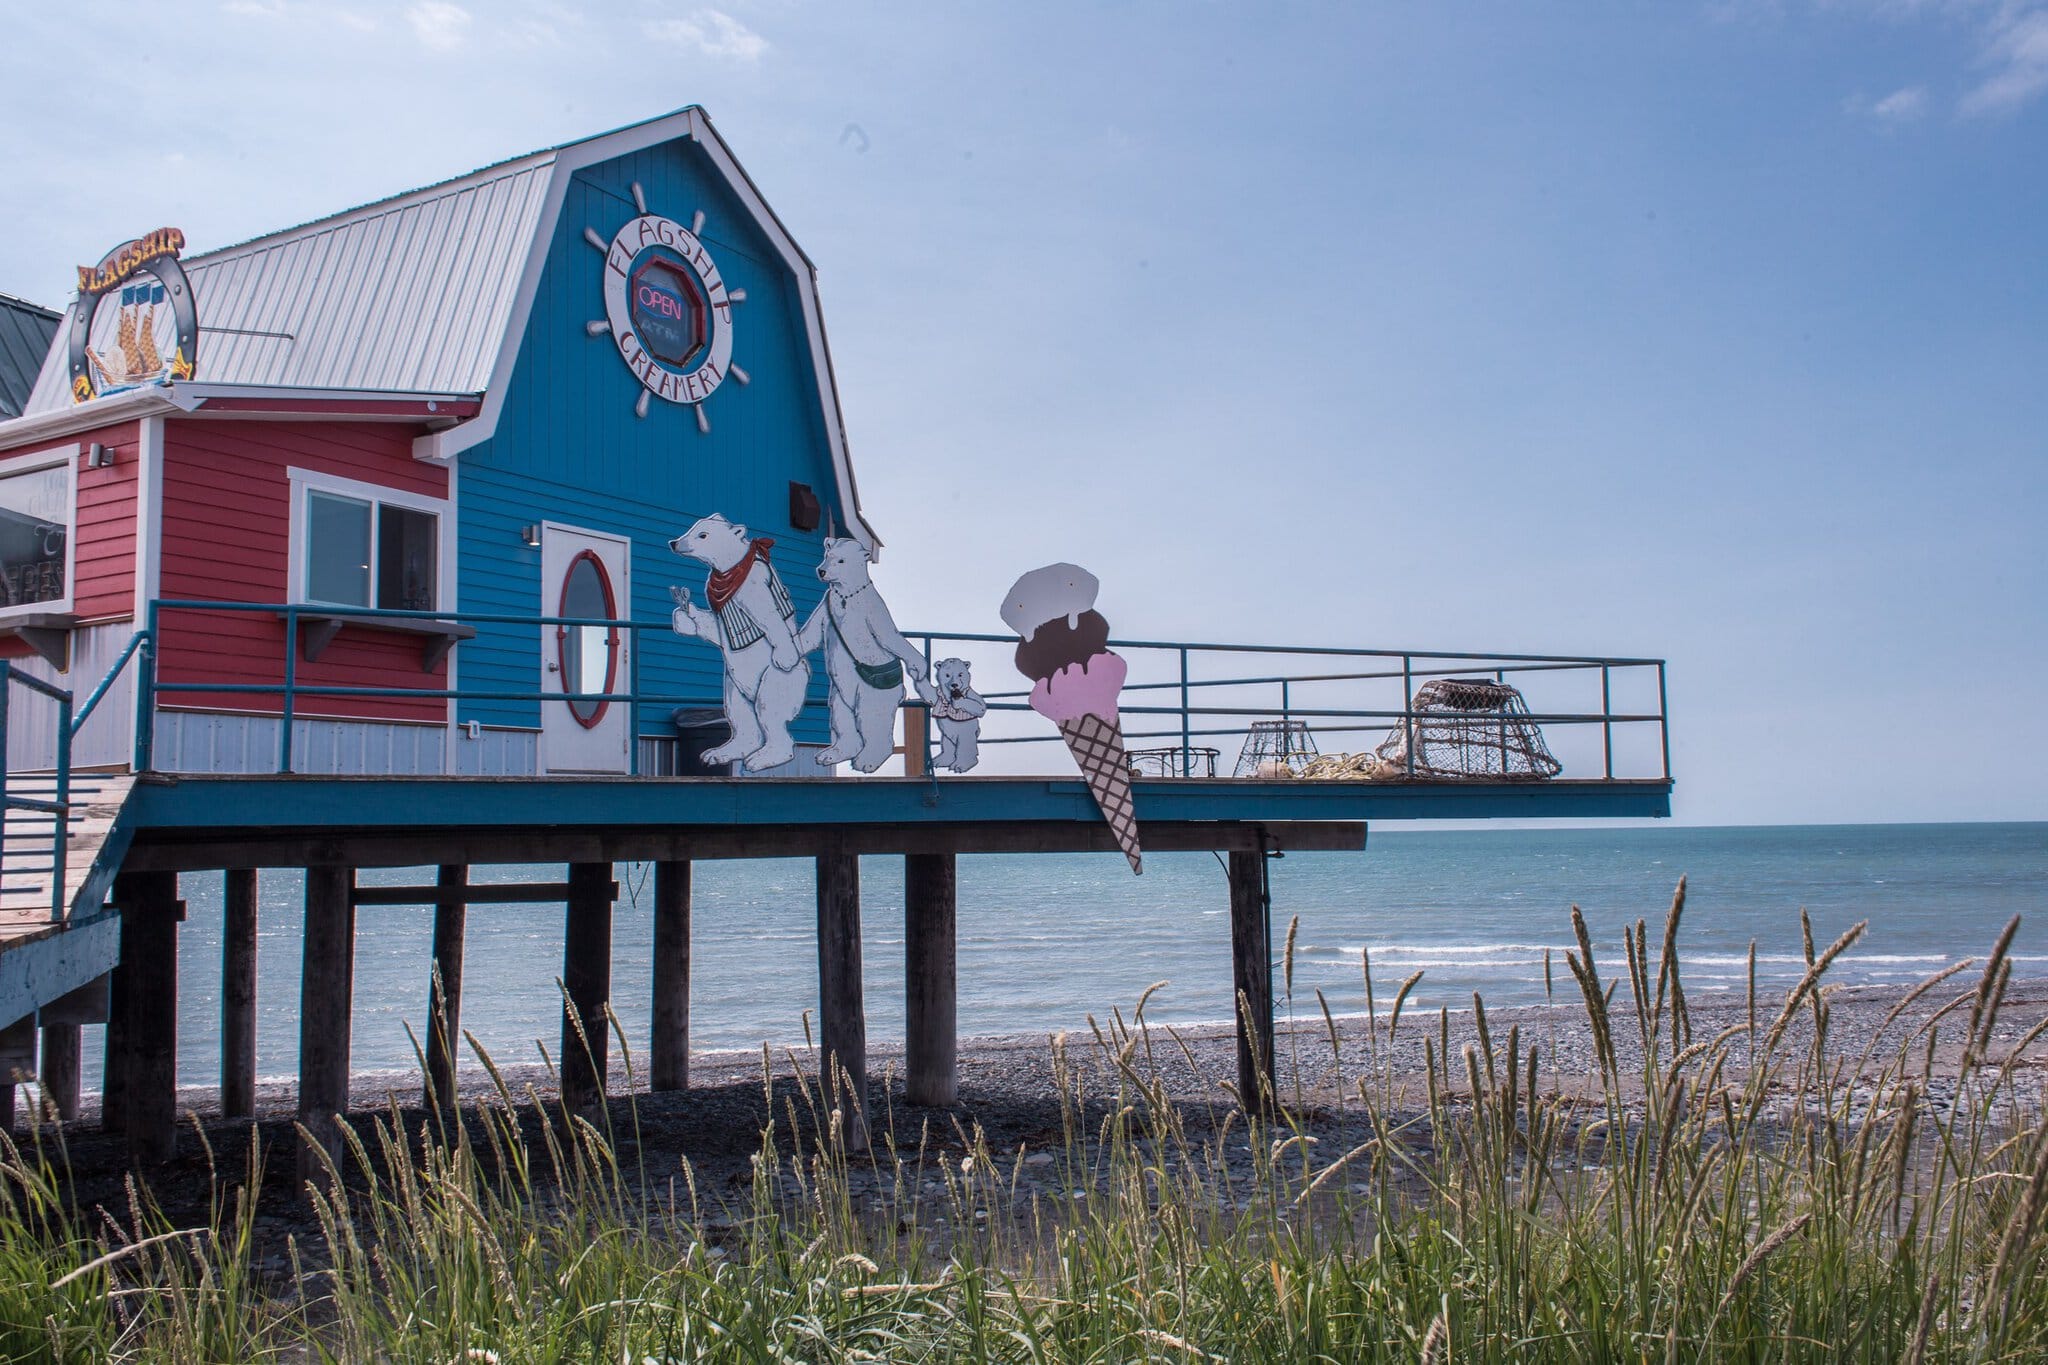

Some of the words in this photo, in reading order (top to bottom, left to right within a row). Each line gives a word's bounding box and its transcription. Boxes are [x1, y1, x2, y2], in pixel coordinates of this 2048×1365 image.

[77, 227, 185, 294] FLAGSHIP
[609, 219, 731, 324] FLAGSHIP
[638, 287, 681, 320] OPEN
[620, 331, 724, 401] CREAMERY
